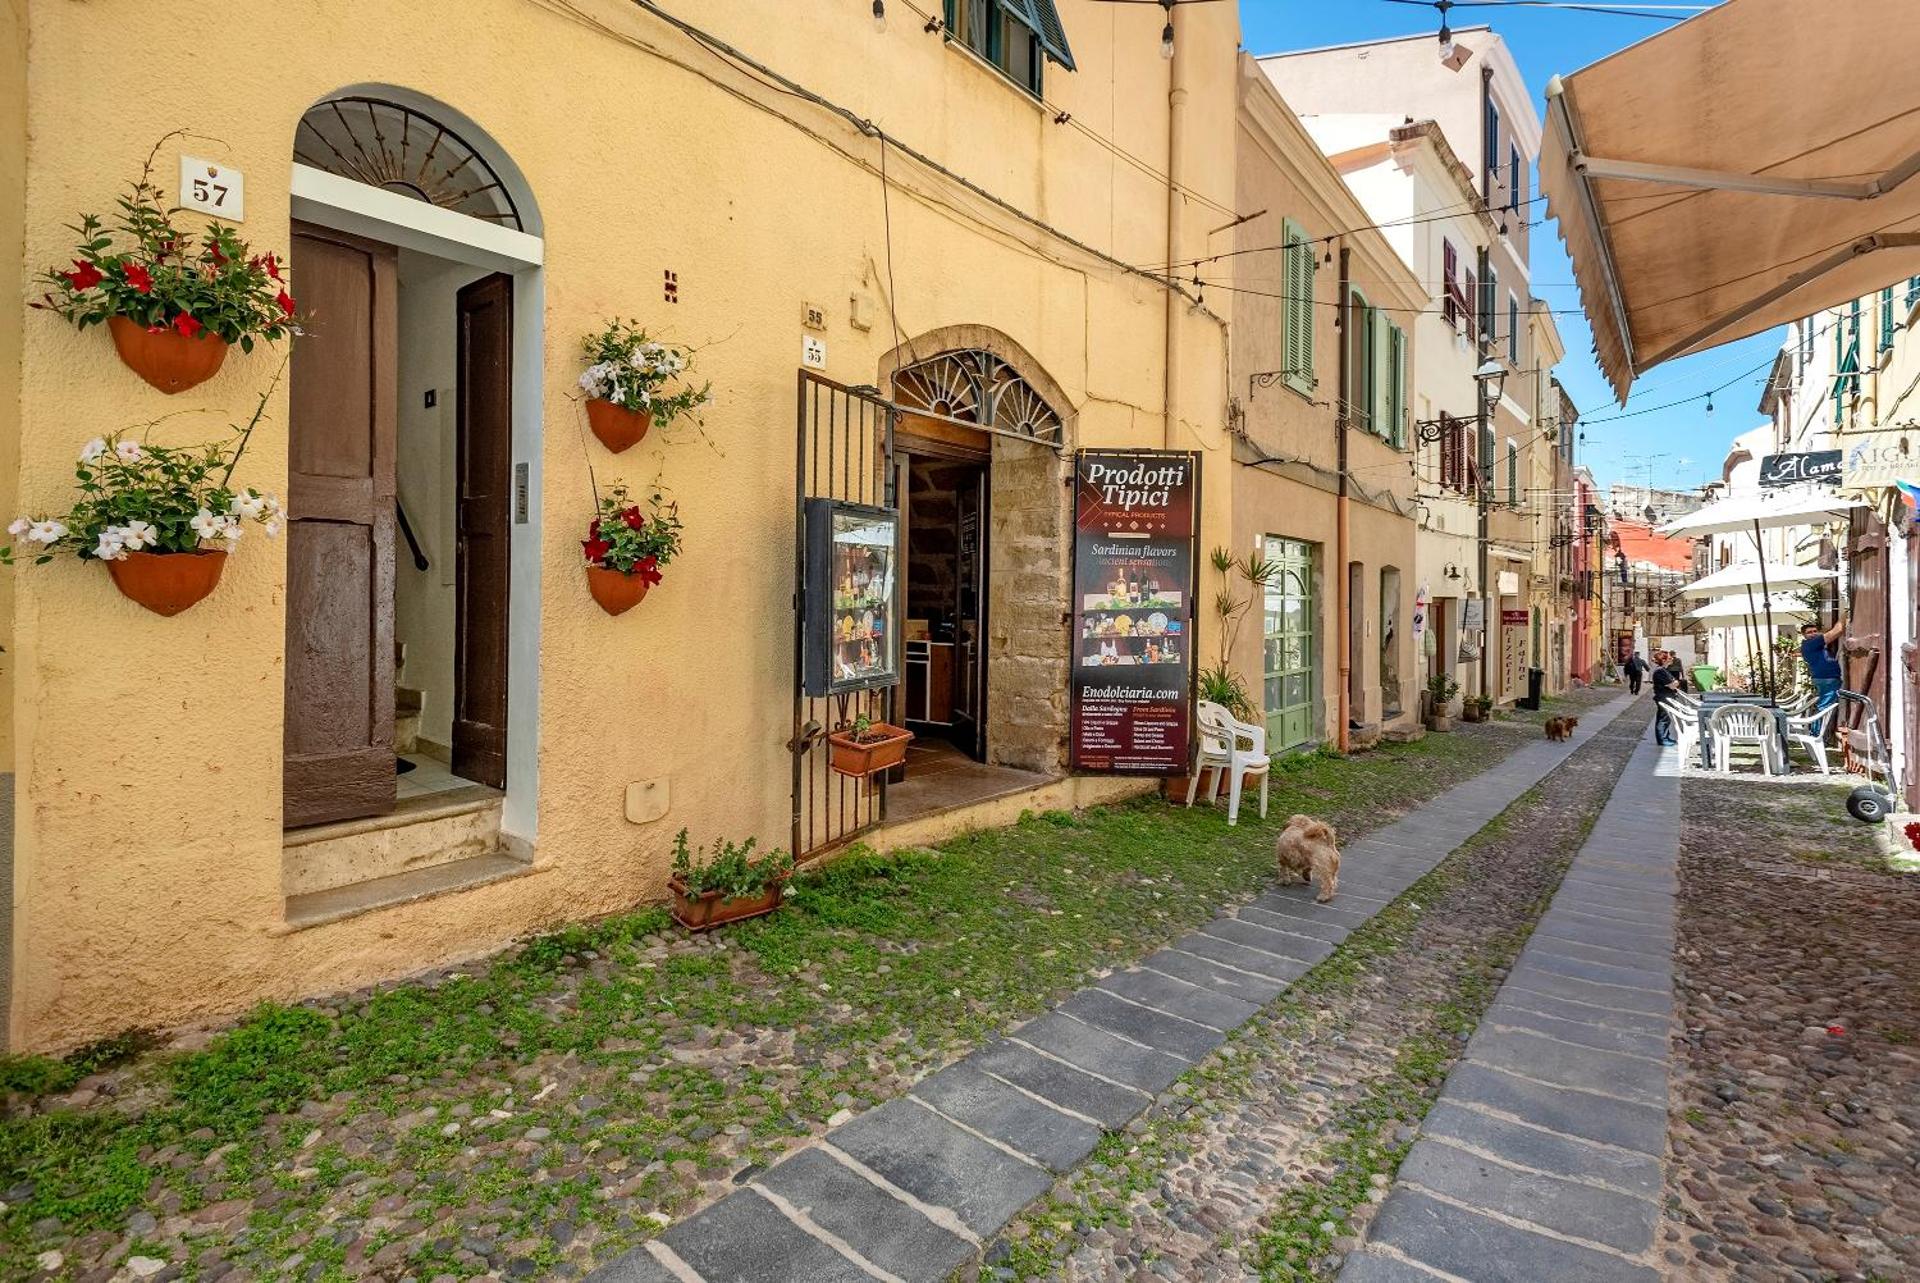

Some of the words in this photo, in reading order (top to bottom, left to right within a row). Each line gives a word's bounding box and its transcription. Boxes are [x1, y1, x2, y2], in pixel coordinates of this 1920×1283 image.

[193, 178, 229, 207] 57
[808, 347, 822, 363] 55
[1087, 463, 1184, 486] Prodotti
[1102, 484, 1170, 511] Tipici
[1091, 543, 1141, 556] Sardinian
[1140, 545, 1177, 559] flavors
[1082, 686, 1179, 700] Enodolciaria.com
